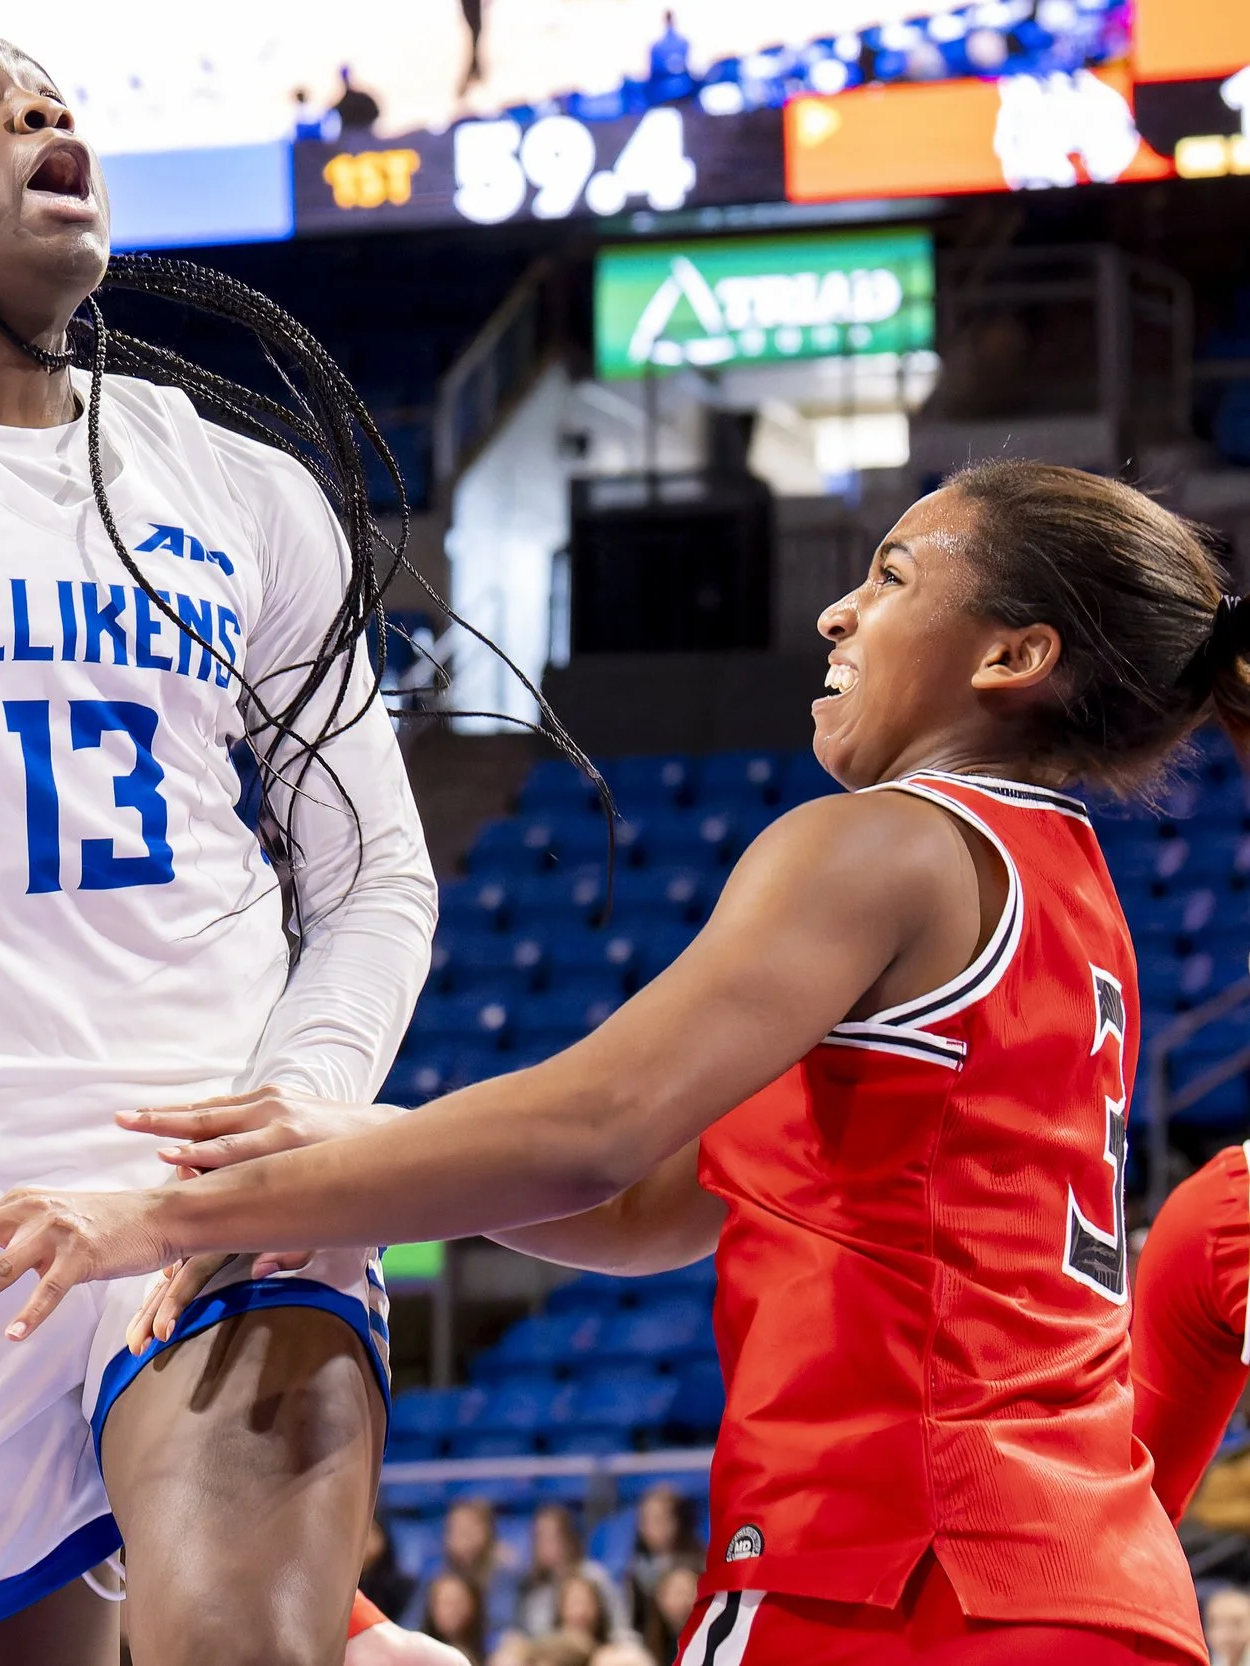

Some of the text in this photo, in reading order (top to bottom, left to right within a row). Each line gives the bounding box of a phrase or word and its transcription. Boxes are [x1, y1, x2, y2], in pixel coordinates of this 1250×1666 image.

[324, 149, 421, 209] 1ST
[454, 107, 696, 224] 59.4
[2, 700, 176, 895] 13
[1062, 961, 1127, 1306] 3
